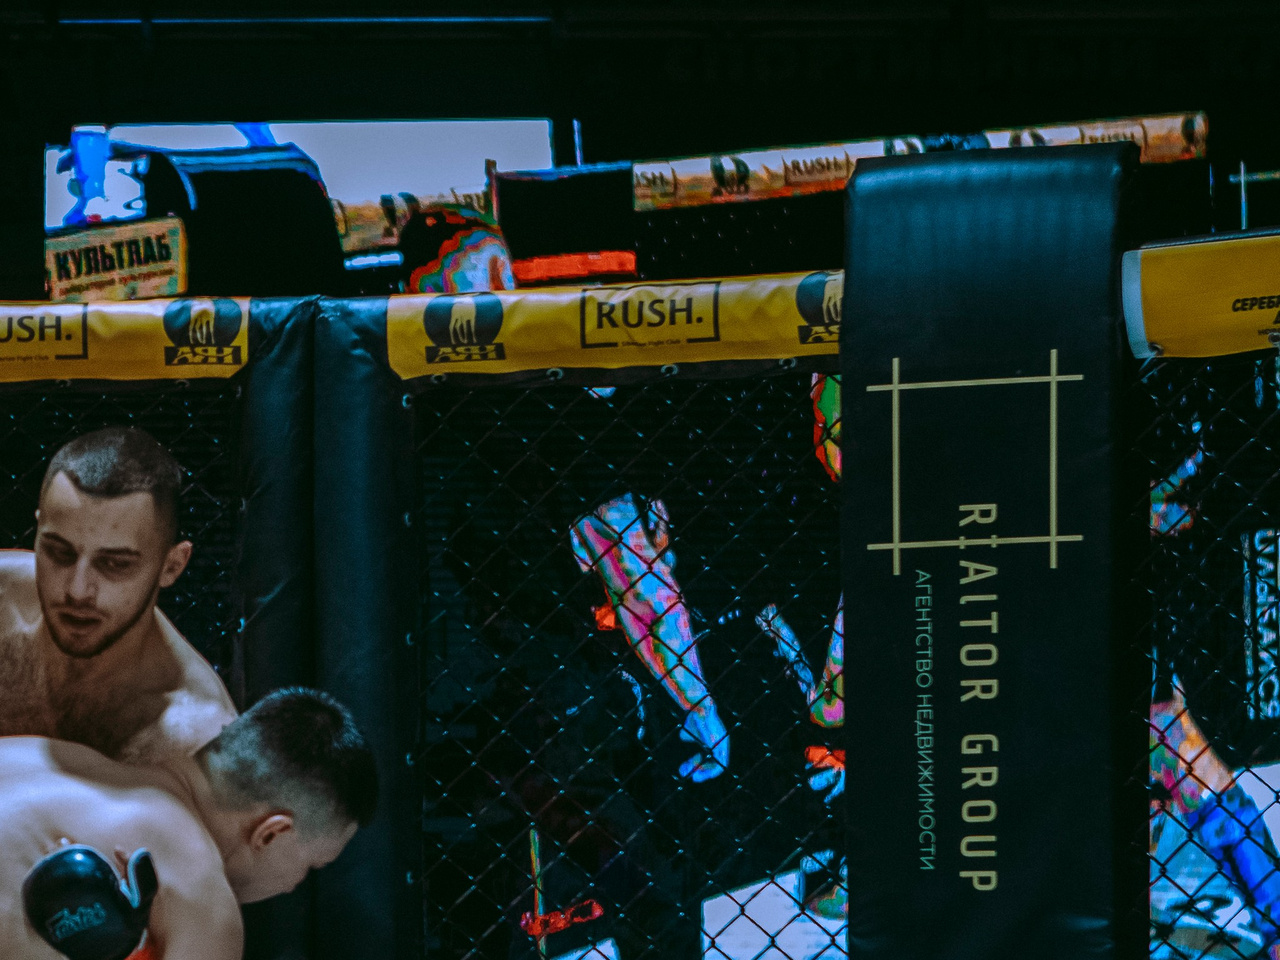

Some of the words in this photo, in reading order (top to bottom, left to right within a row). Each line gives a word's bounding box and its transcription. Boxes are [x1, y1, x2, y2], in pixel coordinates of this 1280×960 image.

[596, 298, 703, 330] RUSH.
[914, 569, 934, 689] АГЕНТСТВО
[914, 695, 936, 870] НЕДВИЖИМОСТИ
[959, 732, 1000, 892] GROUP
